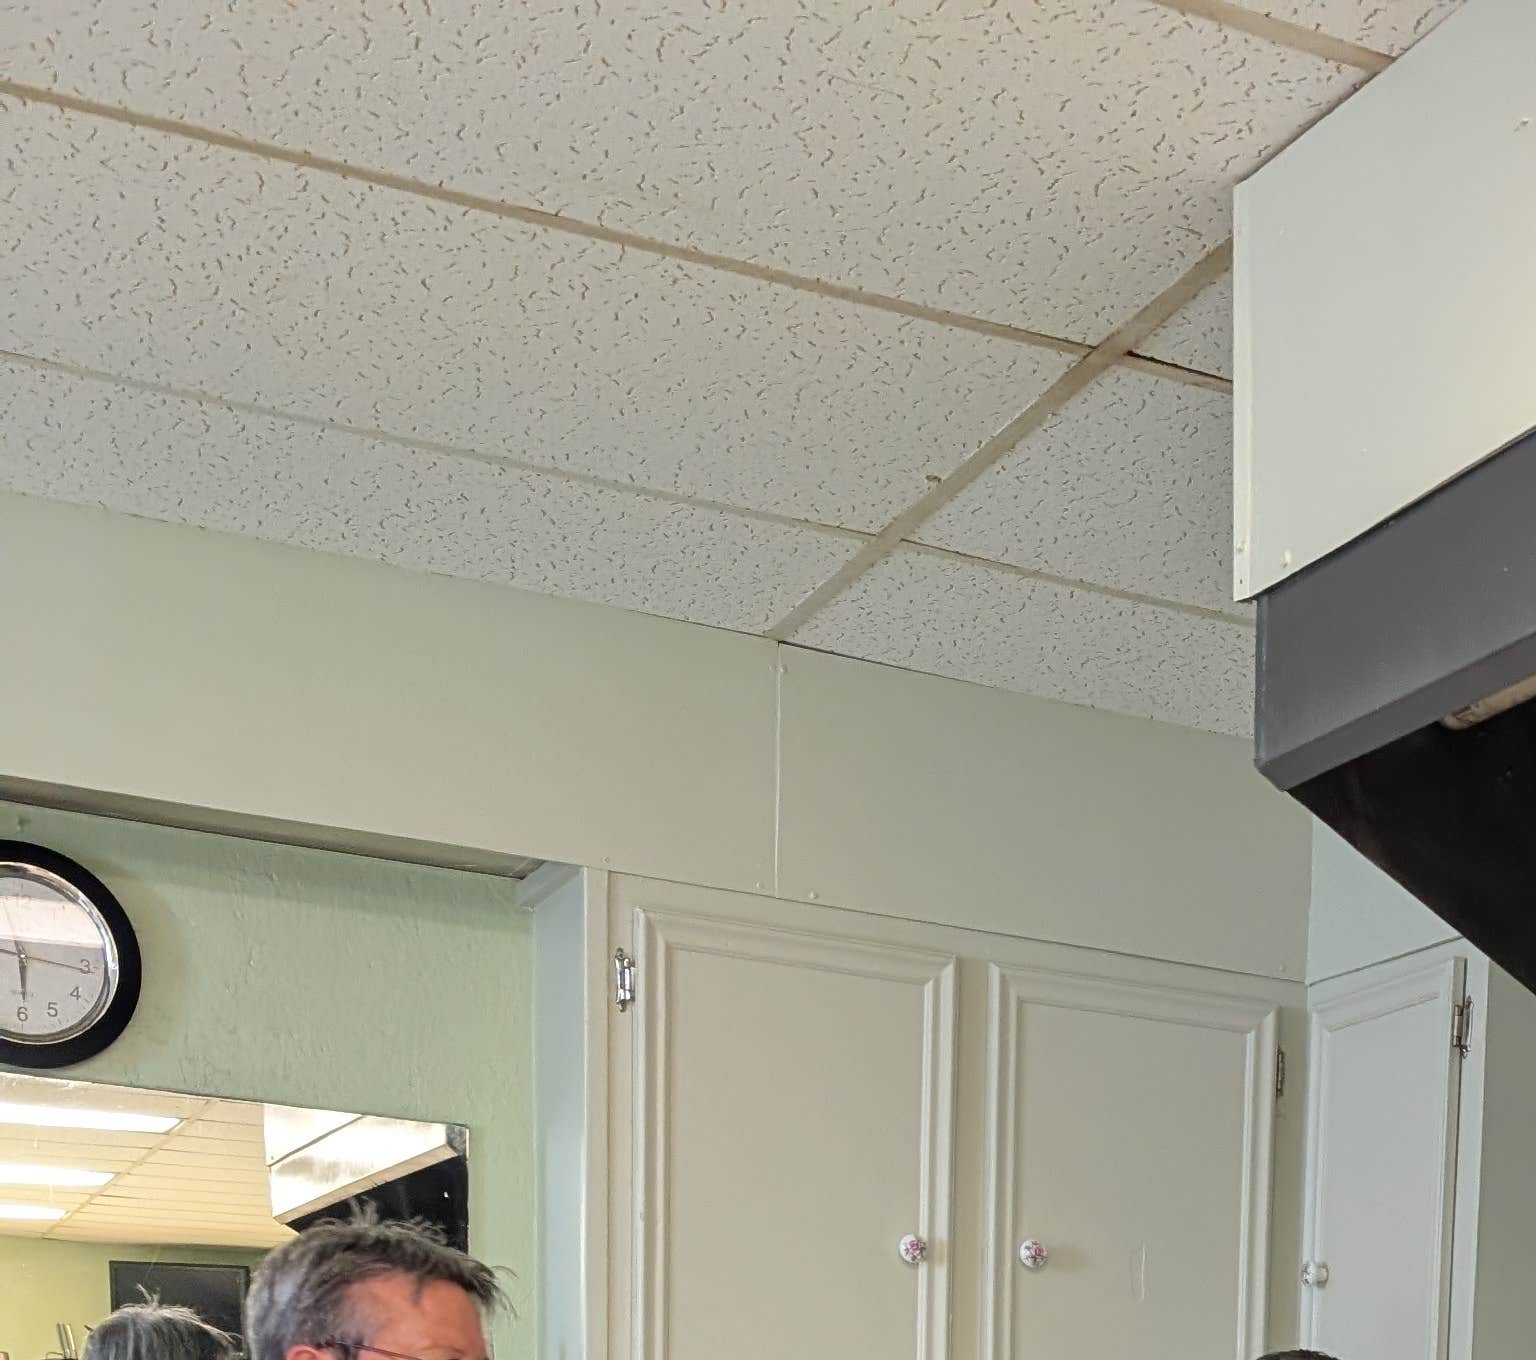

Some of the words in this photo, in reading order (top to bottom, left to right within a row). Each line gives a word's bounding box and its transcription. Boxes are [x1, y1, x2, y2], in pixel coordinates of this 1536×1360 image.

[70, 986, 81, 1001] 4
[17, 1006, 28, 1022] 6
[47, 1002, 58, 1017] 5
